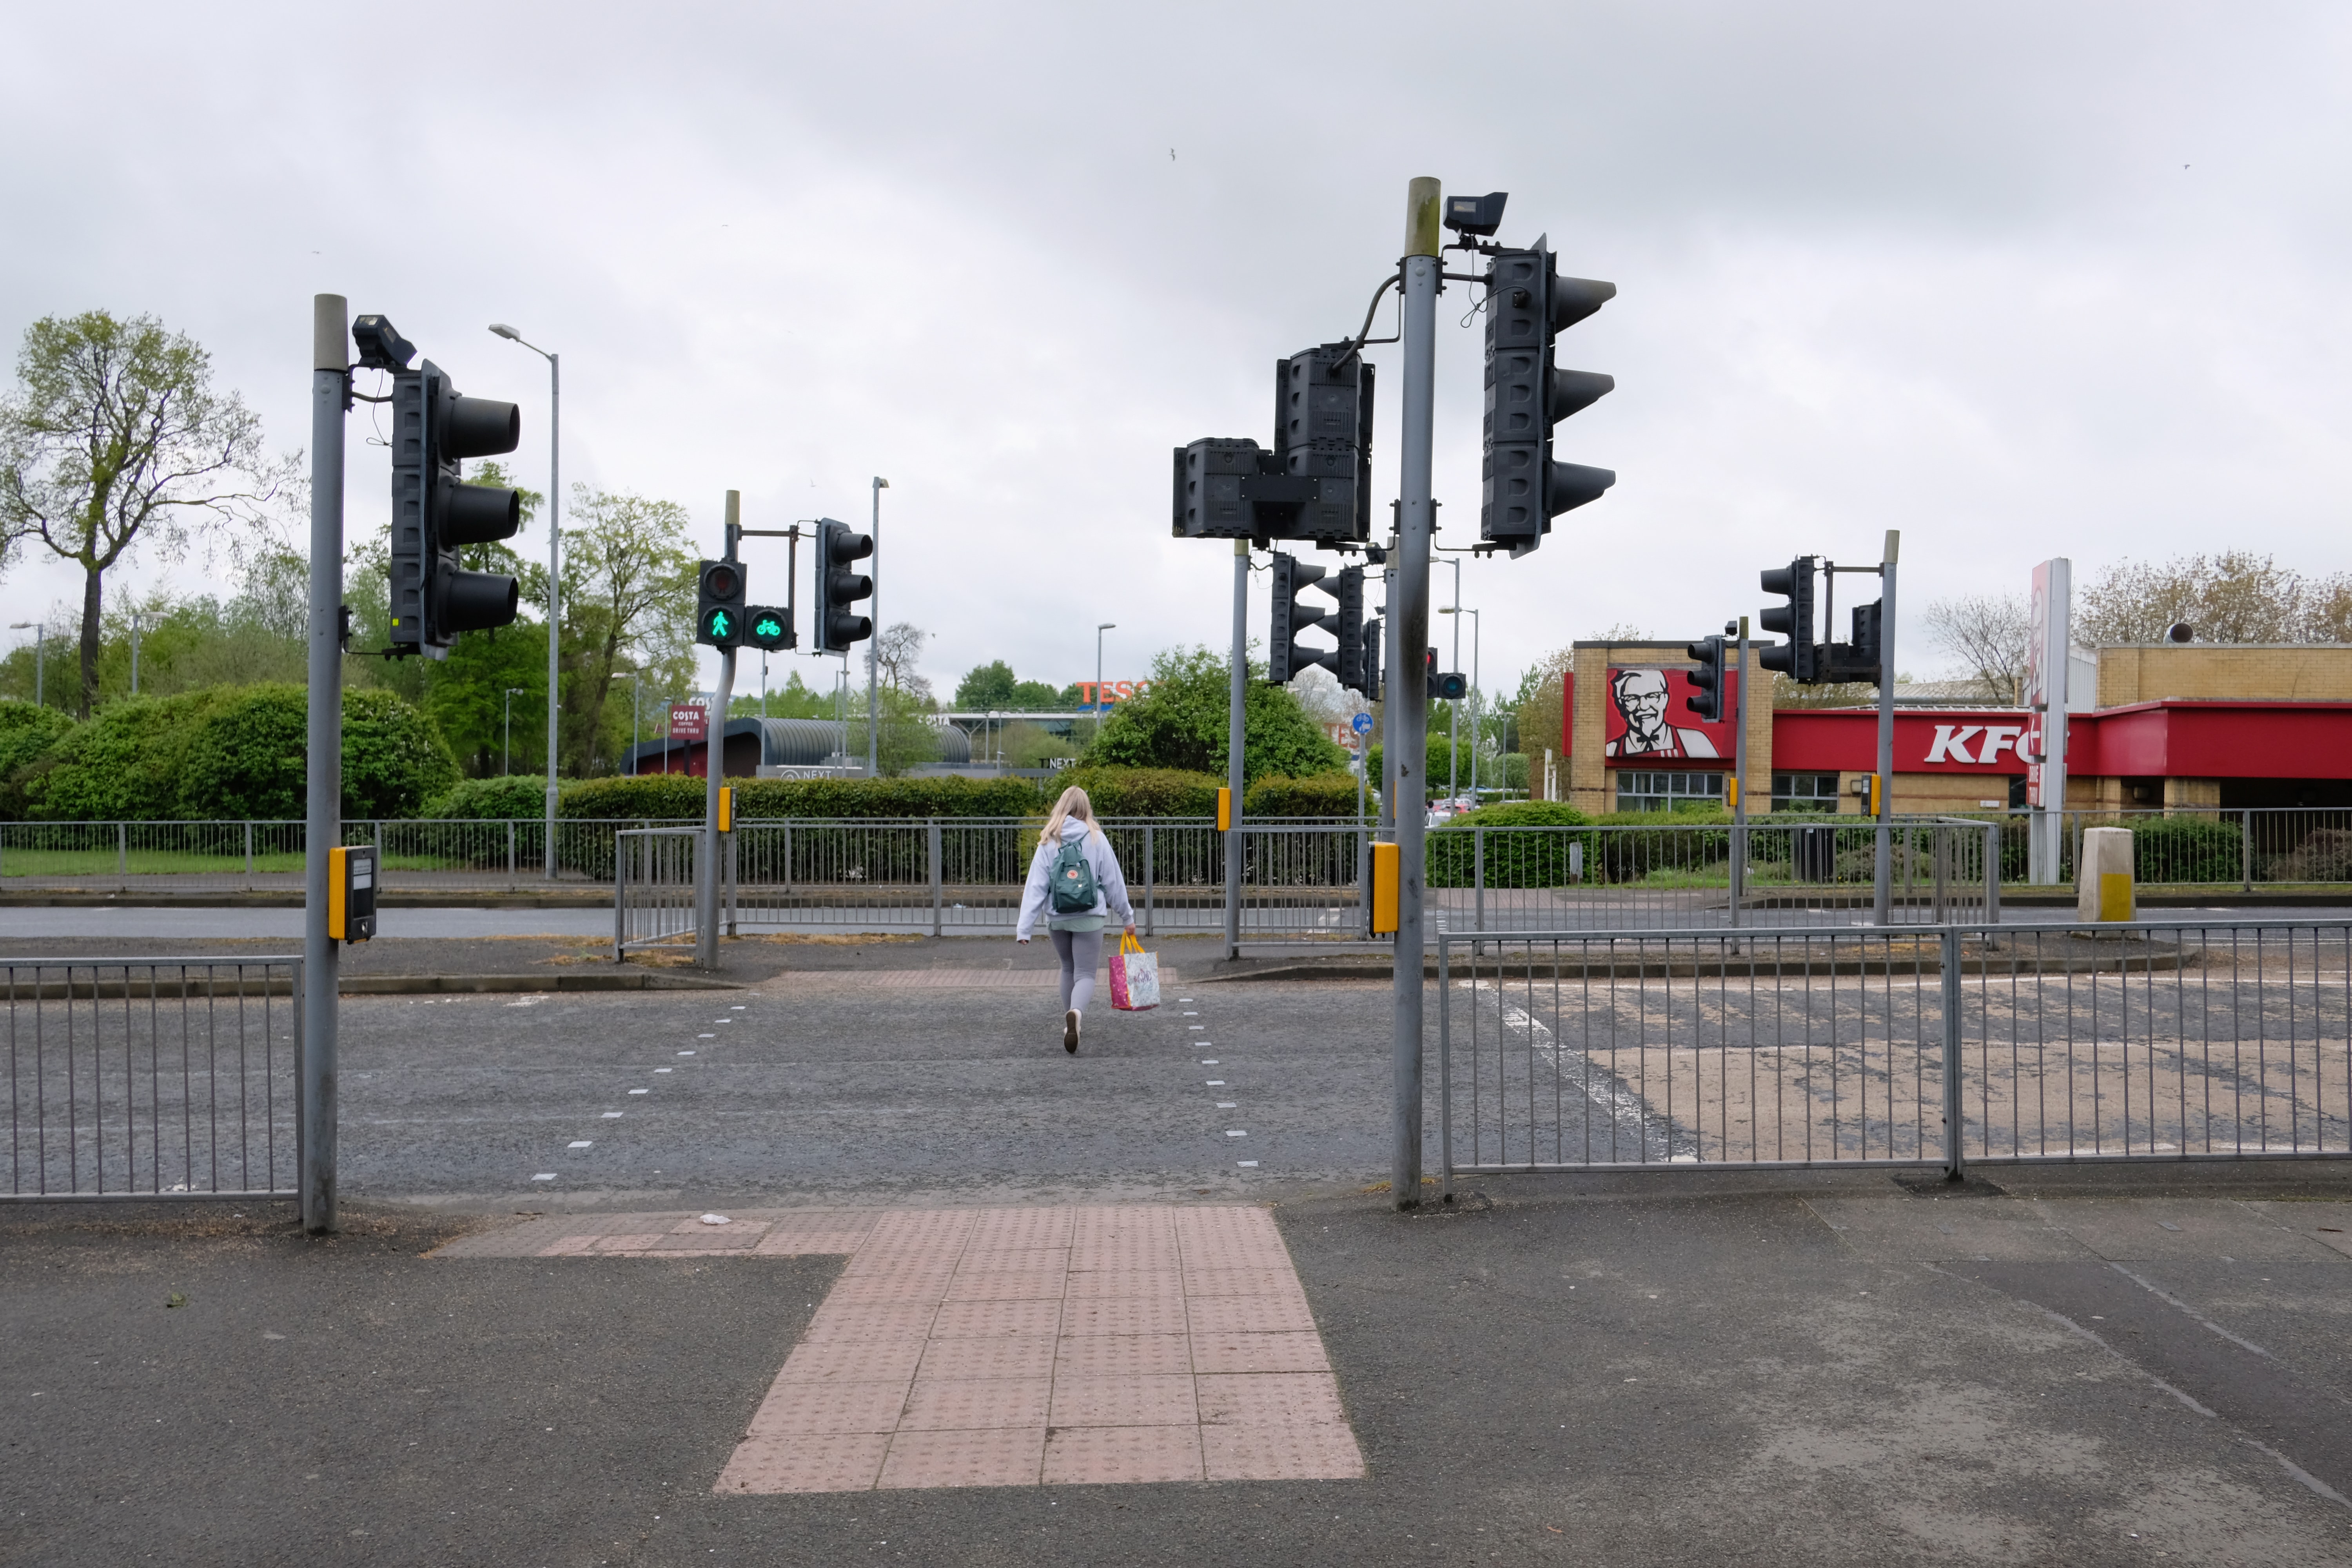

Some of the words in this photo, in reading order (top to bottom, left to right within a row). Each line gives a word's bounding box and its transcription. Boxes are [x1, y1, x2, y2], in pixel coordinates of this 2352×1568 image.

[1076, 681, 1166, 702] TES
[688, 697, 713, 710] COS
[673, 711, 699, 721] COSTA
[1049, 758, 1076, 769] NEXT
[804, 770, 831, 780] NEXT
